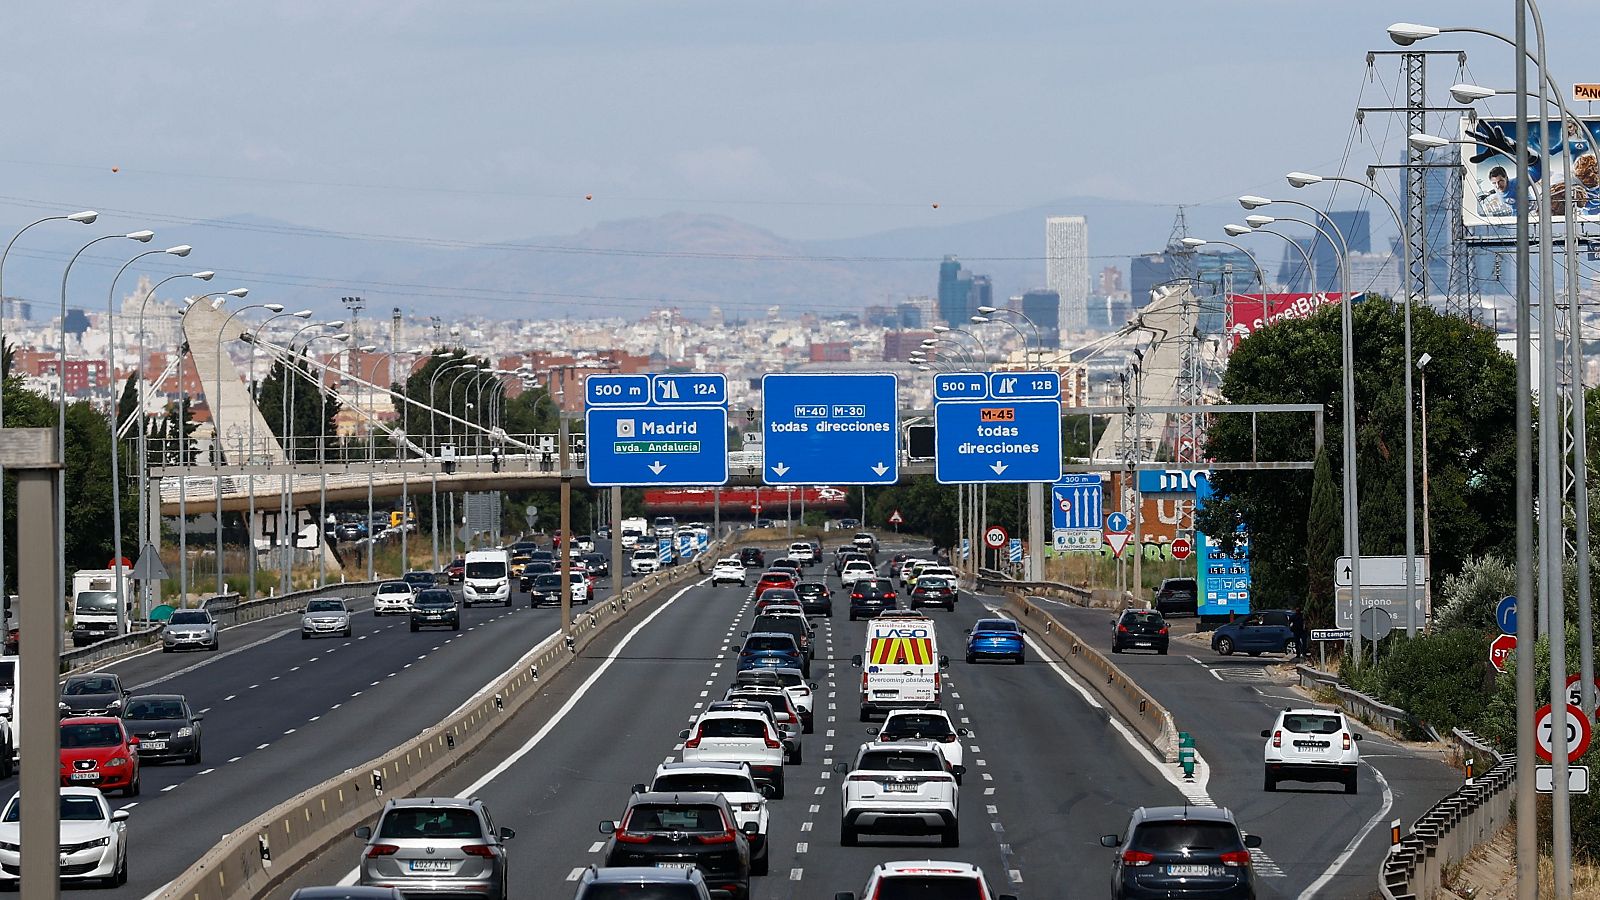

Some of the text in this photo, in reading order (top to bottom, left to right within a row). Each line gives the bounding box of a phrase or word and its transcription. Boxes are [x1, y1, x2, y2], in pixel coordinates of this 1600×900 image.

[693, 383, 717, 395] 12A
[942, 382, 981, 391] 500 m
[1031, 380, 1052, 390] 12B
[595, 385, 641, 396] 500 m
[796, 407, 826, 416] M-40
[834, 406, 863, 416] M-30
[981, 409, 1013, 420] M-45
[642, 421, 697, 435] Madrid
[771, 420, 890, 432] todas direcciones
[976, 425, 1019, 437] todas
[615, 443, 643, 452] avda.
[958, 441, 1039, 454] direcciones
[989, 533, 1003, 542] 100
[876, 629, 927, 638] LASO
